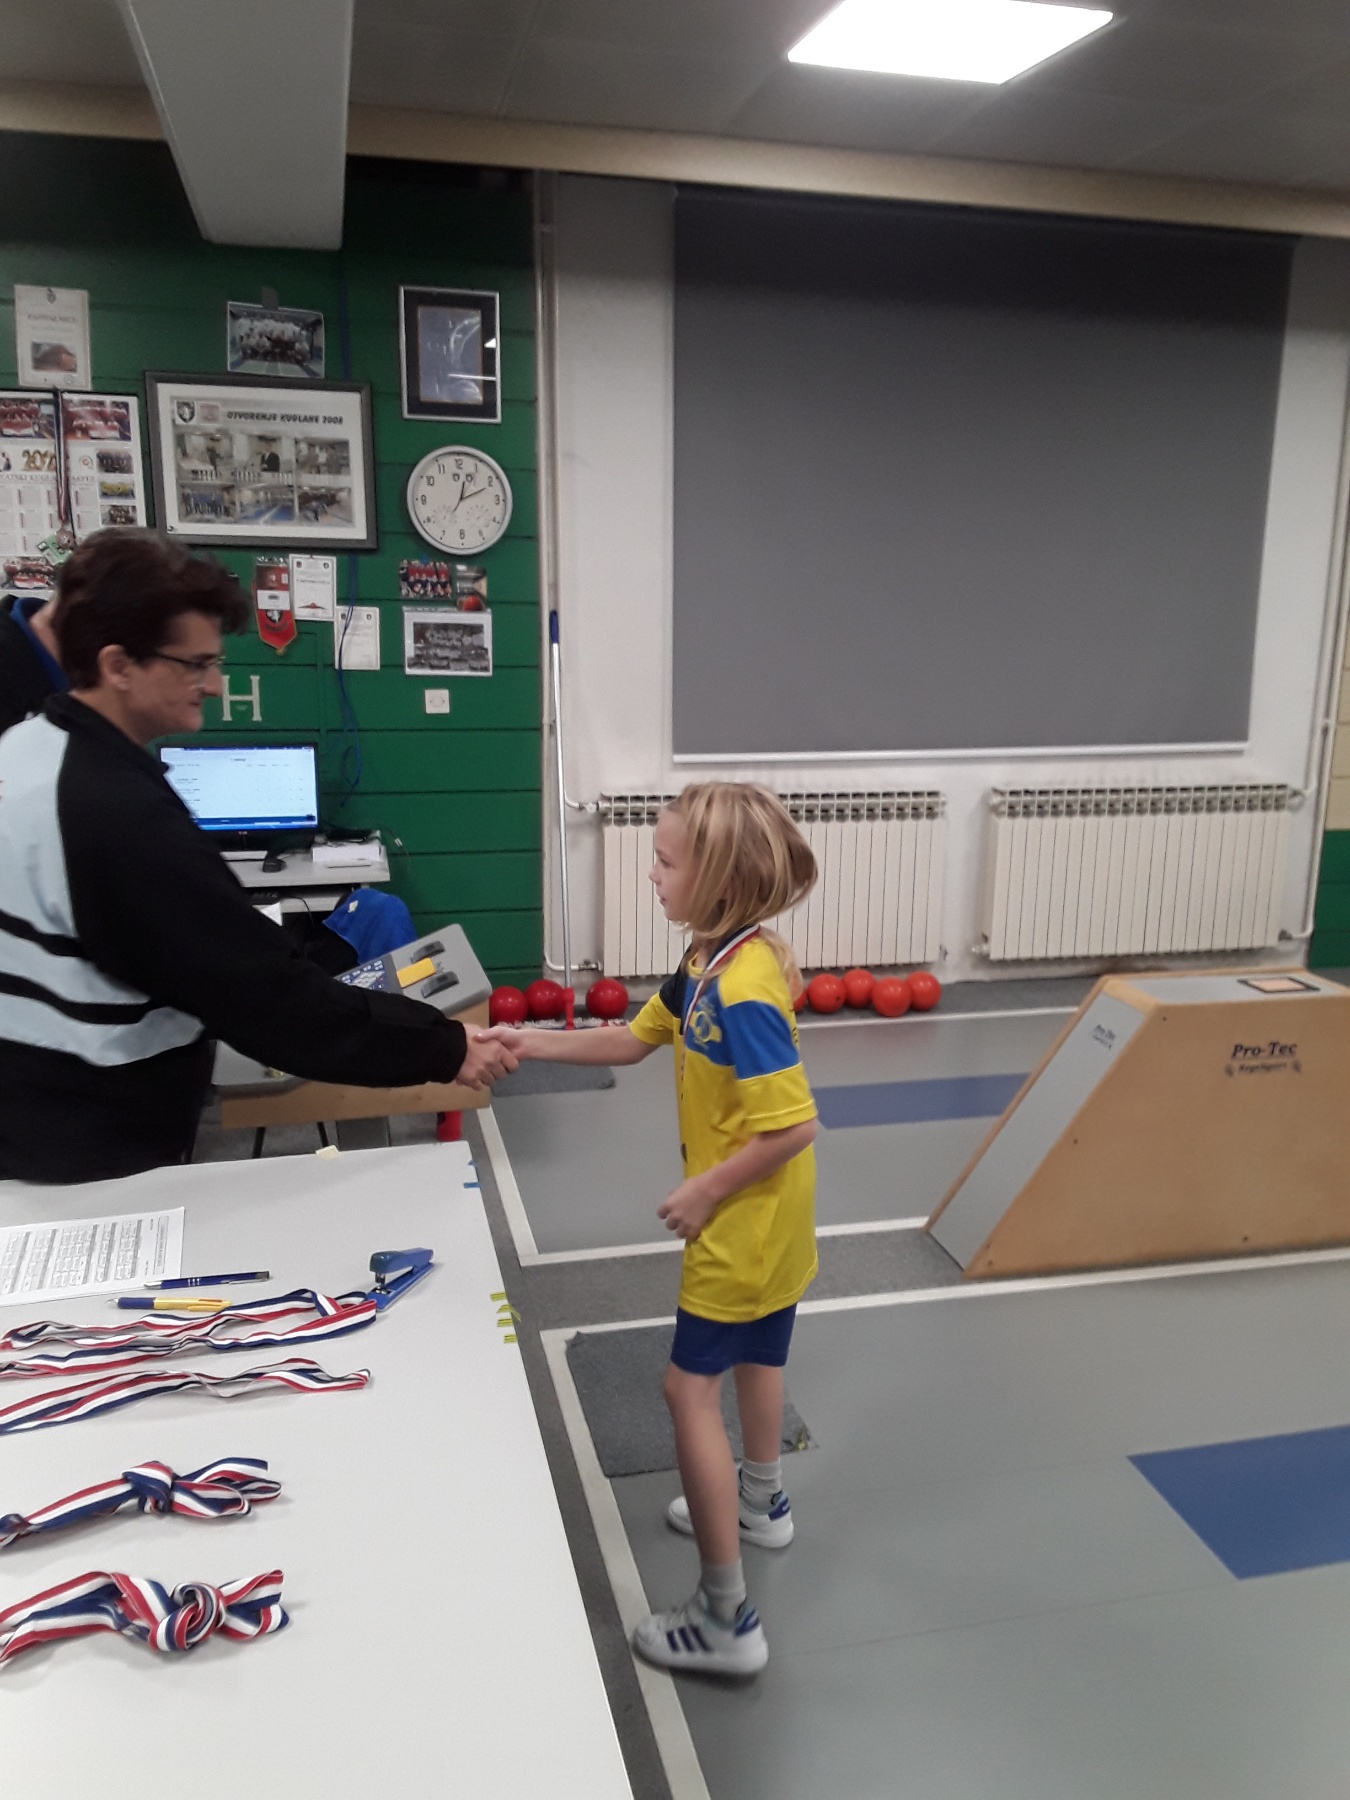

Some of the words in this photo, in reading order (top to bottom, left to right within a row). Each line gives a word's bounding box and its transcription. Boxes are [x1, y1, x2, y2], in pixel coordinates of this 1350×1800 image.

[226, 410, 277, 422] OTVORENJE
[280, 413, 319, 424] KUGLANE
[322, 415, 343, 425] 2008
[438, 463, 445, 474] 11
[455, 458, 463, 470] 12
[425, 475, 435, 486] 10
[488, 475, 493, 487] 2
[420, 494, 427, 505] 9
[495, 494, 500, 505] 3
[459, 528, 466, 540] 6
[221, 674, 262, 721] H
